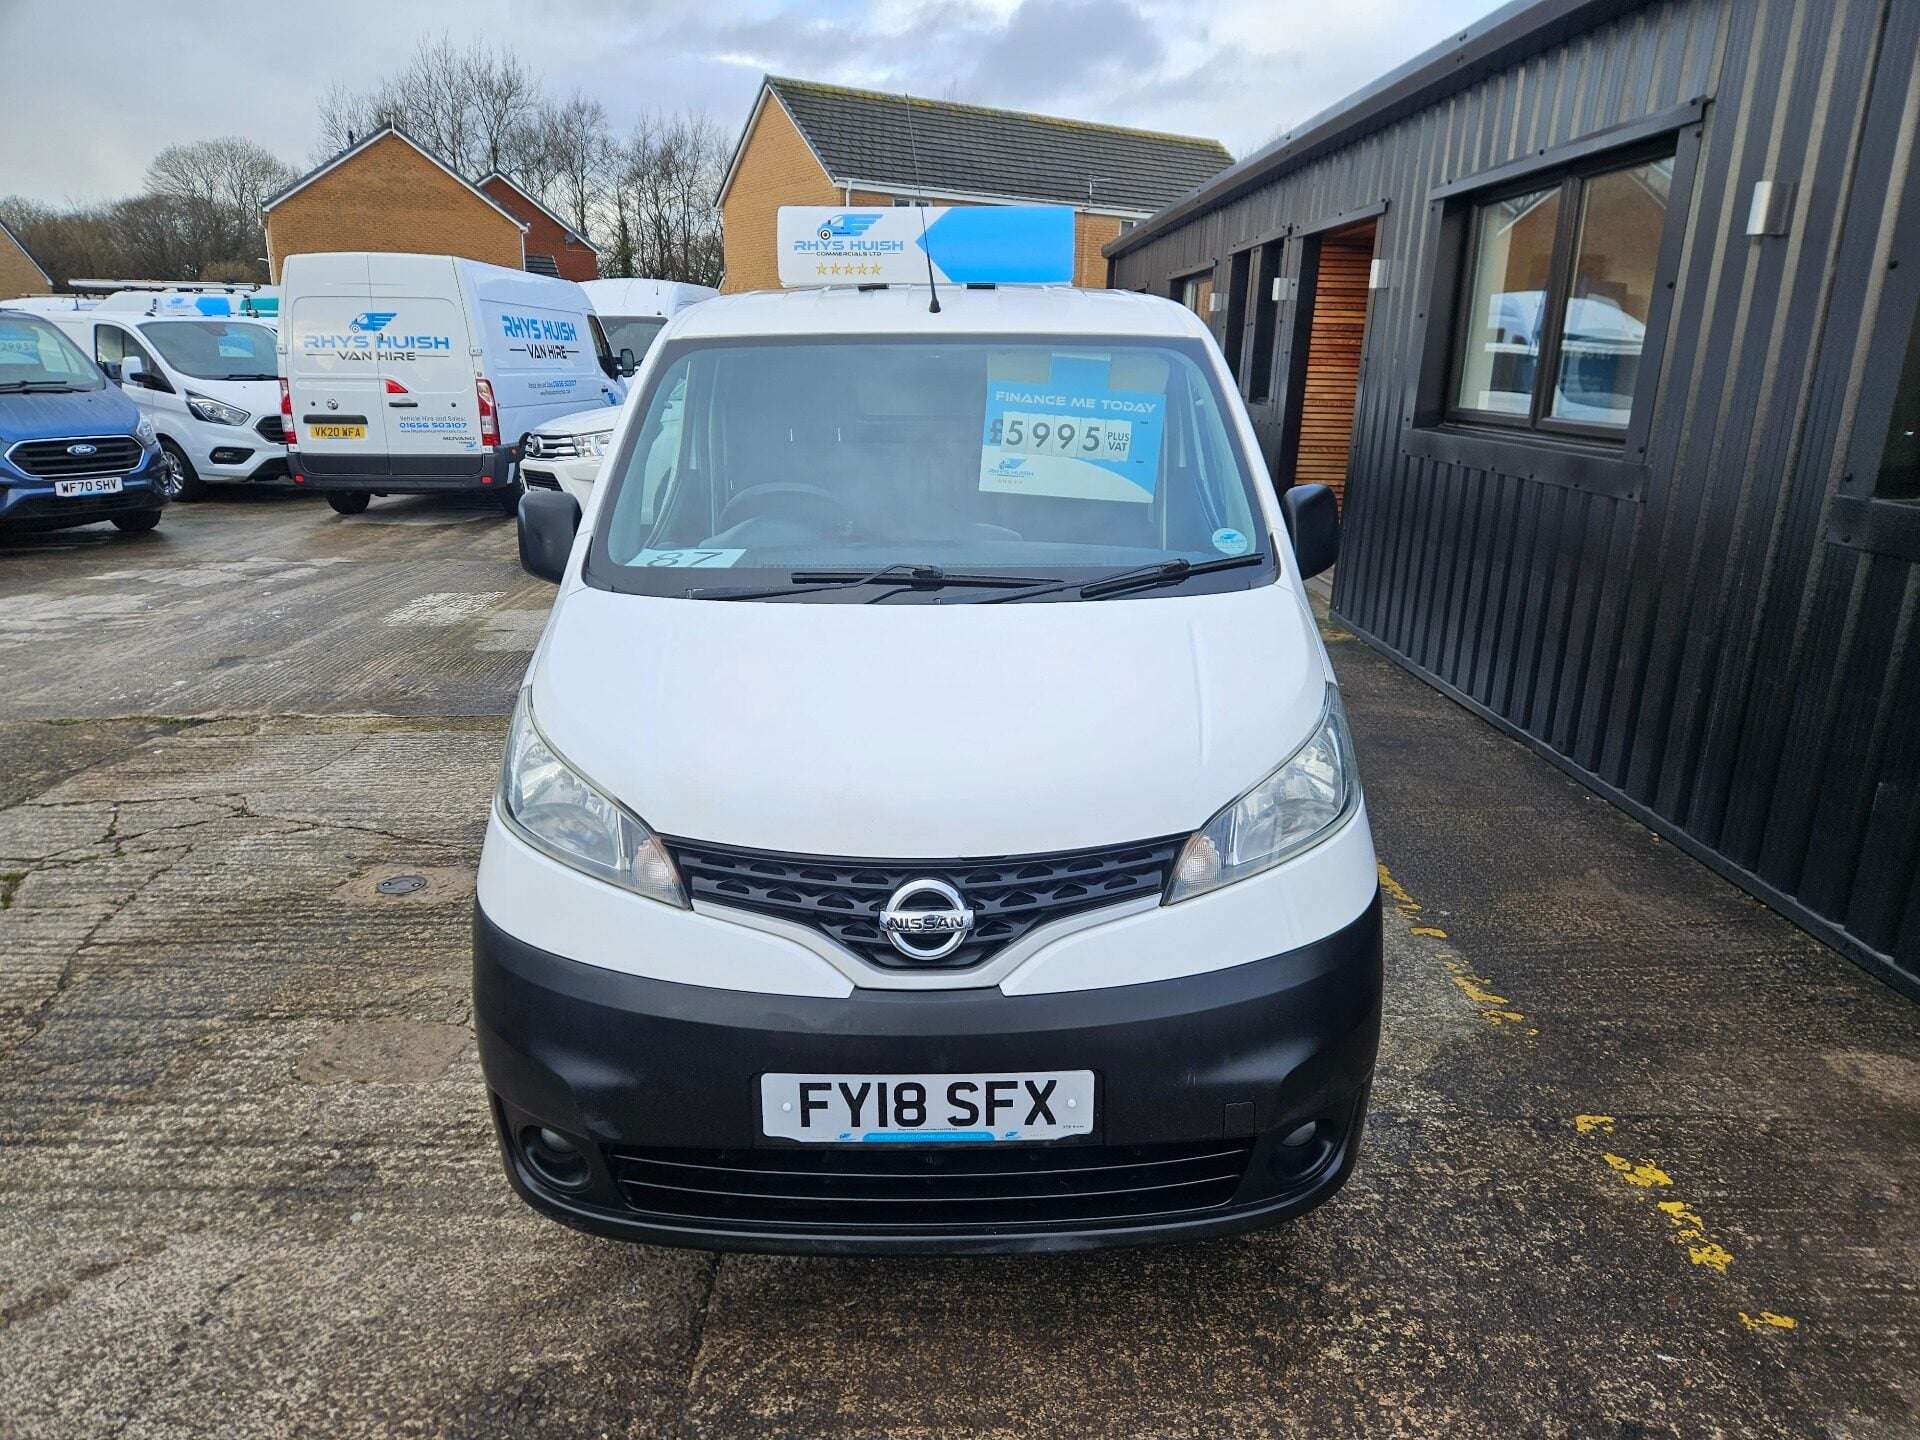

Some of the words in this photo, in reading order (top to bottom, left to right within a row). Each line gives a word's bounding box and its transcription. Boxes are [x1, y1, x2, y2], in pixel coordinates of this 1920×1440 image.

[794, 240, 844, 250] RHYS
[850, 240, 904, 250] HUISH
[502, 315, 542, 340] RHYS
[541, 319, 578, 342] HUISH
[304, 335, 369, 348] RHYS
[377, 335, 450, 350] HUISH
[337, 351, 372, 361] VAN
[377, 351, 417, 361] HIRE
[526, 343, 547, 359] VAN
[548, 345, 567, 360] HIRE
[995, 391, 1067, 406] FINANCE
[1071, 397, 1097, 409] ME
[1102, 400, 1156, 413] TODAY
[315, 426, 340, 437] VK20
[1107, 431, 1130, 442] PLUS
[1108, 441, 1127, 452] VAT
[61, 481, 93, 494] WF70
[95, 479, 117, 491] SHV
[887, 915, 964, 931] NISSAN
[799, 1082, 928, 1128] FY18
[946, 1080, 1057, 1126] SFX
